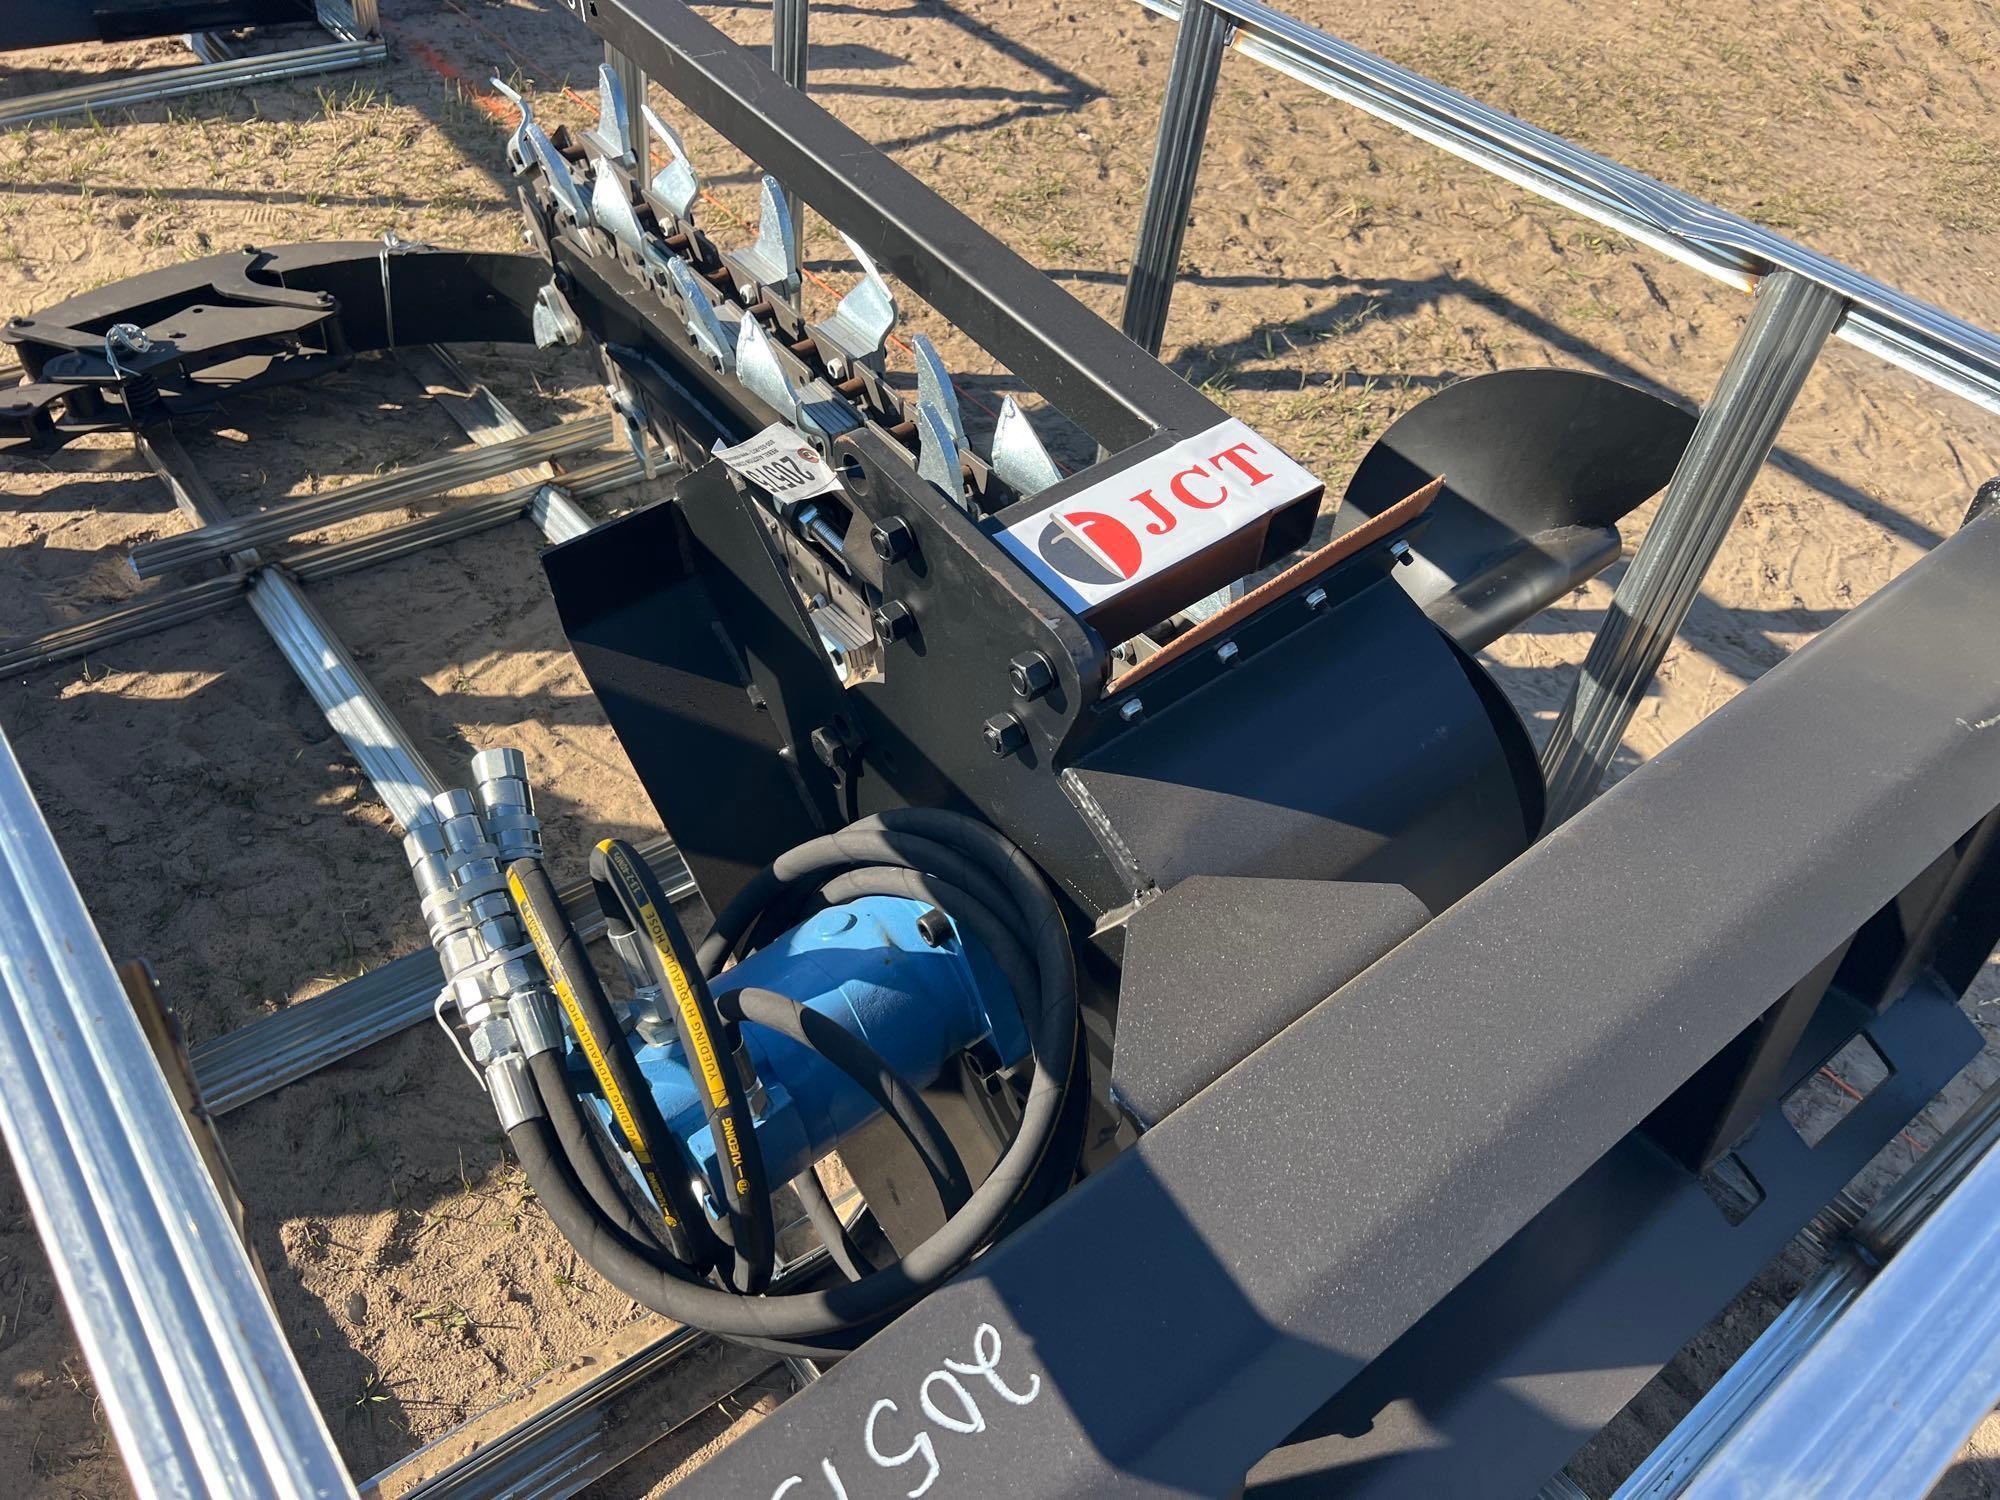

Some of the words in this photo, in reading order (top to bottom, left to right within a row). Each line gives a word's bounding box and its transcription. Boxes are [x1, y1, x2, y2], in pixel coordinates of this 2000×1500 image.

[745, 455, 816, 493] 20575
[1129, 442, 1274, 535] JCT
[646, 911, 666, 944] HOSE
[661, 945, 696, 1018] HYDRAULIC
[577, 1022, 615, 1092] HYDRAULIC
[691, 1021, 718, 1080] YUEDING
[613, 1094, 640, 1143] YUEDING
[721, 1117, 743, 1168] YUEDING
